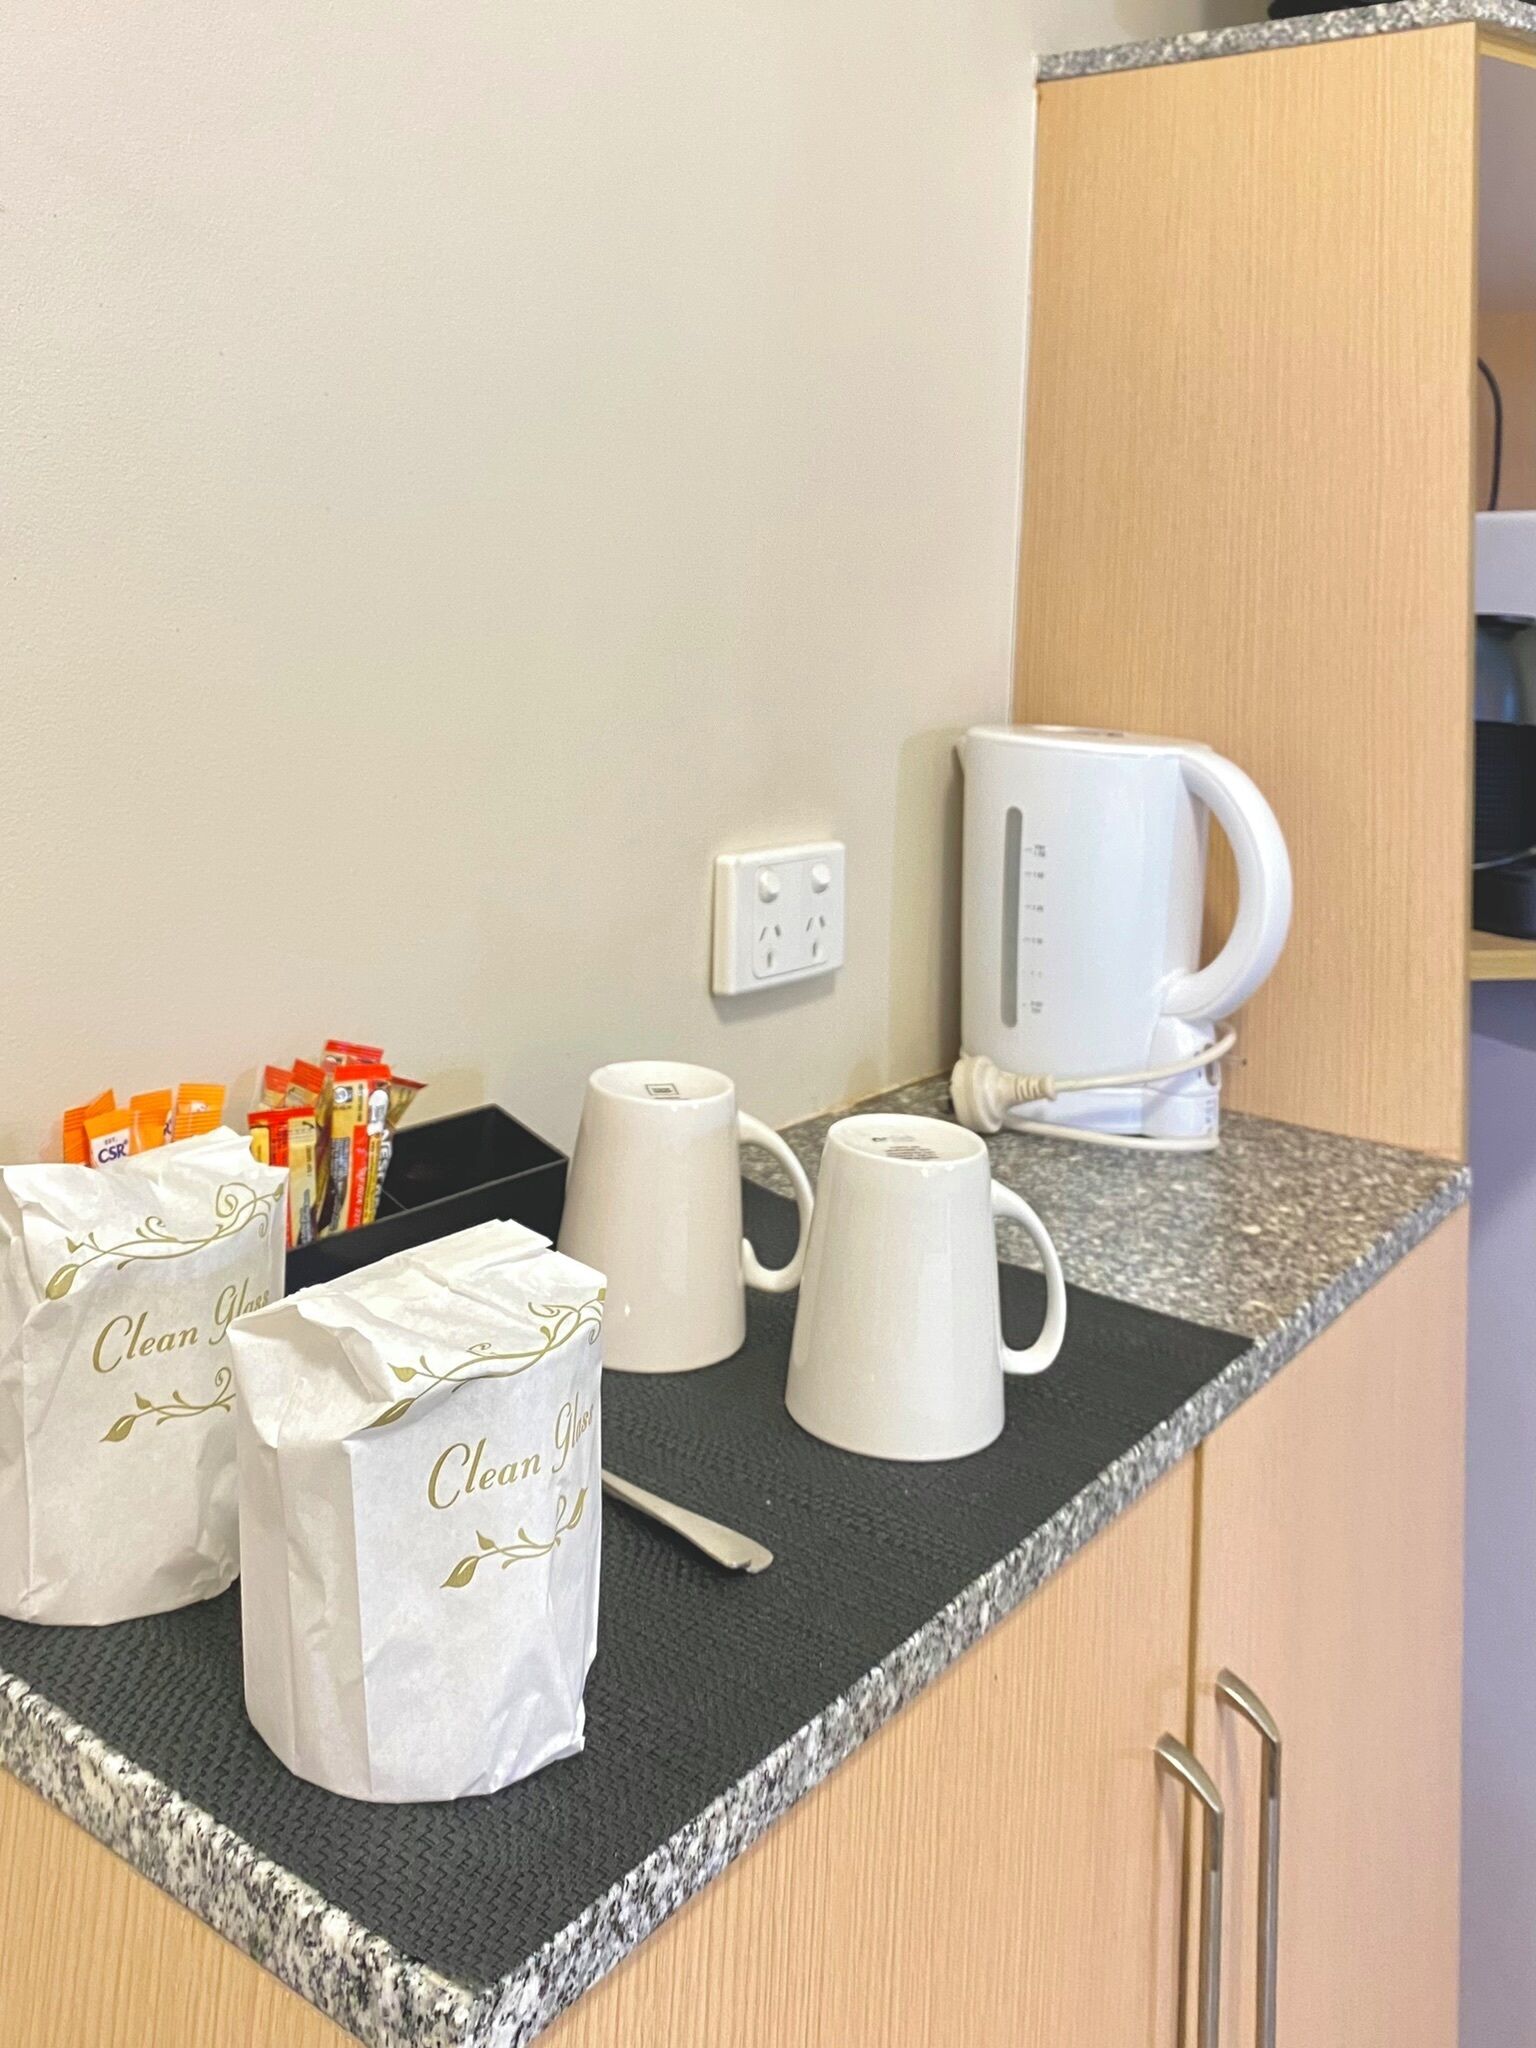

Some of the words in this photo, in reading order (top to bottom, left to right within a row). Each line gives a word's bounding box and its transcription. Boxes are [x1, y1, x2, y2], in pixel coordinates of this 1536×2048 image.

[97, 1143, 127, 1164] CSR
[92, 1310, 199, 1374] Clean
[208, 1276, 269, 1346] Glass
[427, 1437, 542, 1510] Clean
